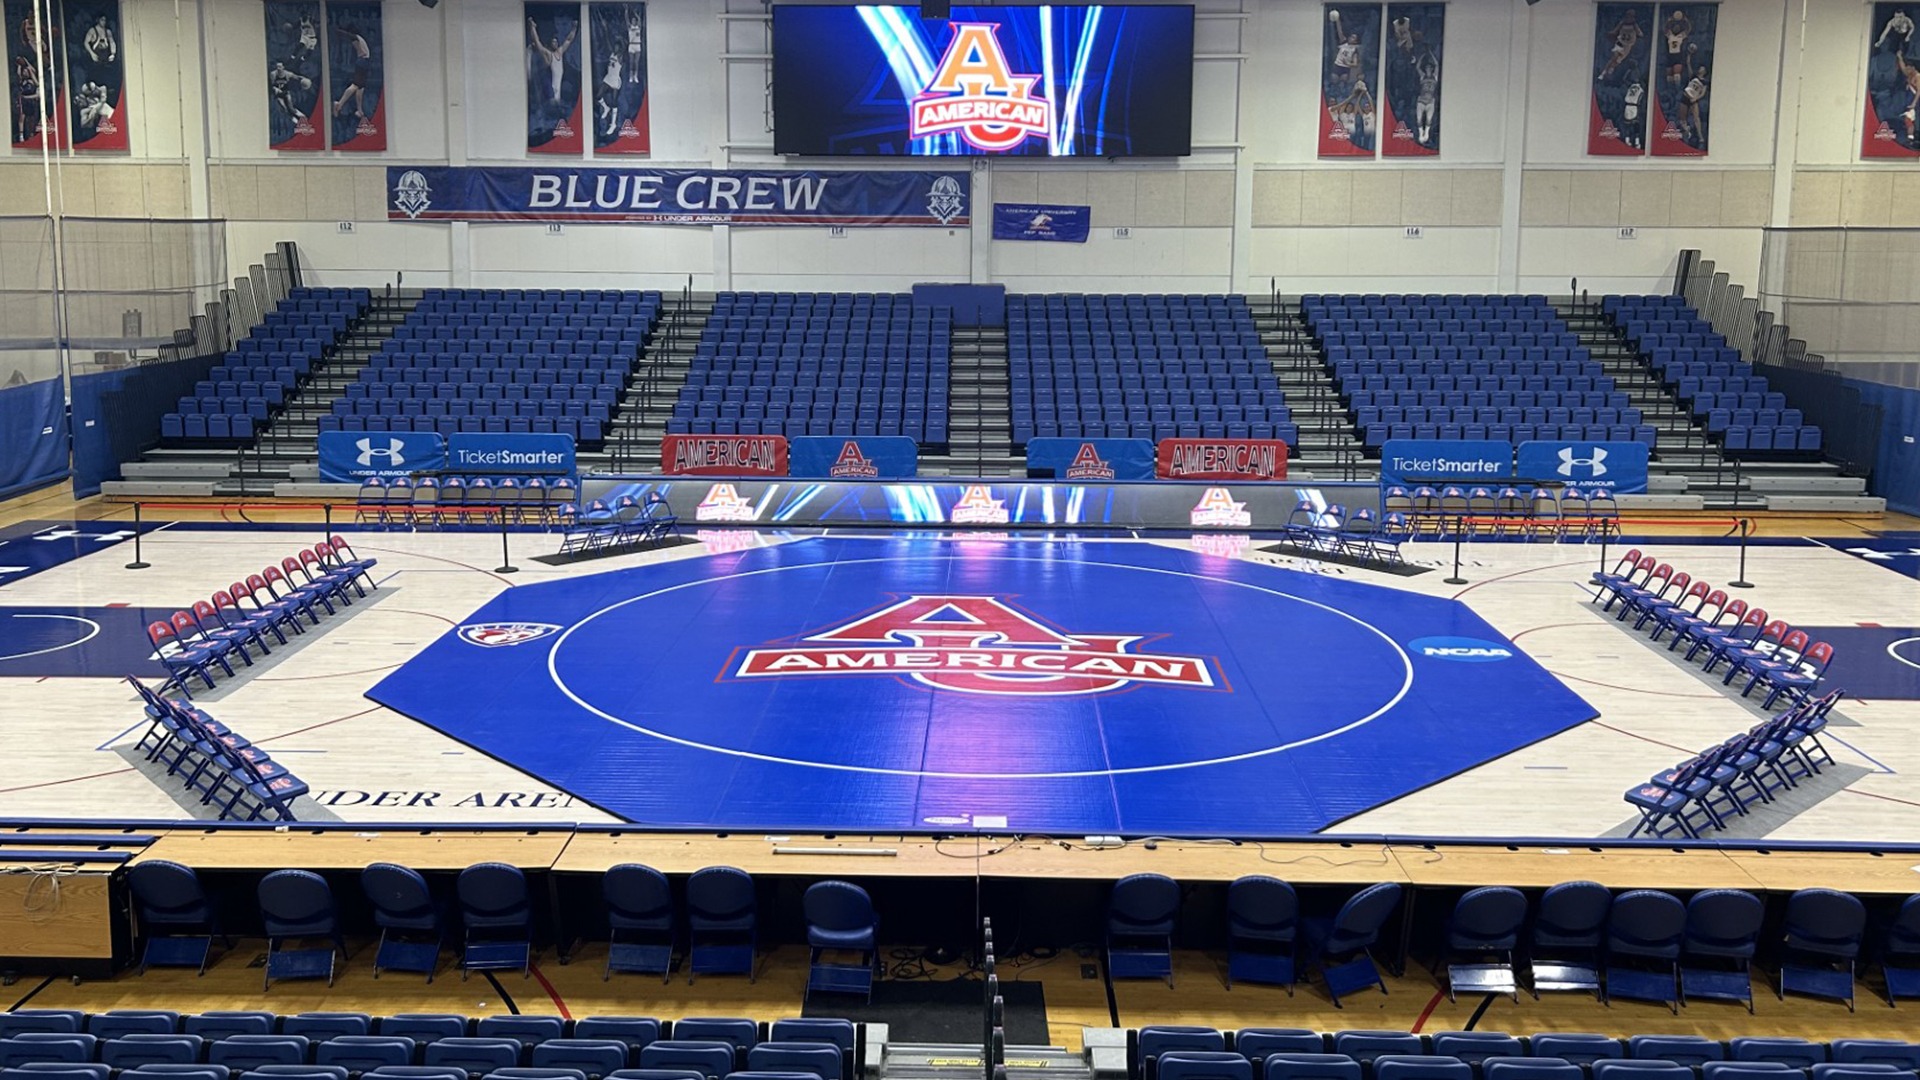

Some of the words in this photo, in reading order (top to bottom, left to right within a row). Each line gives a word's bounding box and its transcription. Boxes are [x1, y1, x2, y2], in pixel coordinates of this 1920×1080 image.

[920, 101, 1043, 125] AMERICAN
[528, 174, 664, 209] BLUE
[676, 176, 829, 211] CREW
[458, 449, 564, 464] TicketSmarter
[673, 439, 775, 472] AMERICAN
[1169, 444, 1276, 478] AMERICAN
[1392, 457, 1501, 472] TicketSmarter
[833, 468, 875, 476] AMERICAN
[765, 651, 1185, 677] AMERICAN
[1424, 647, 1513, 657] NCAA
